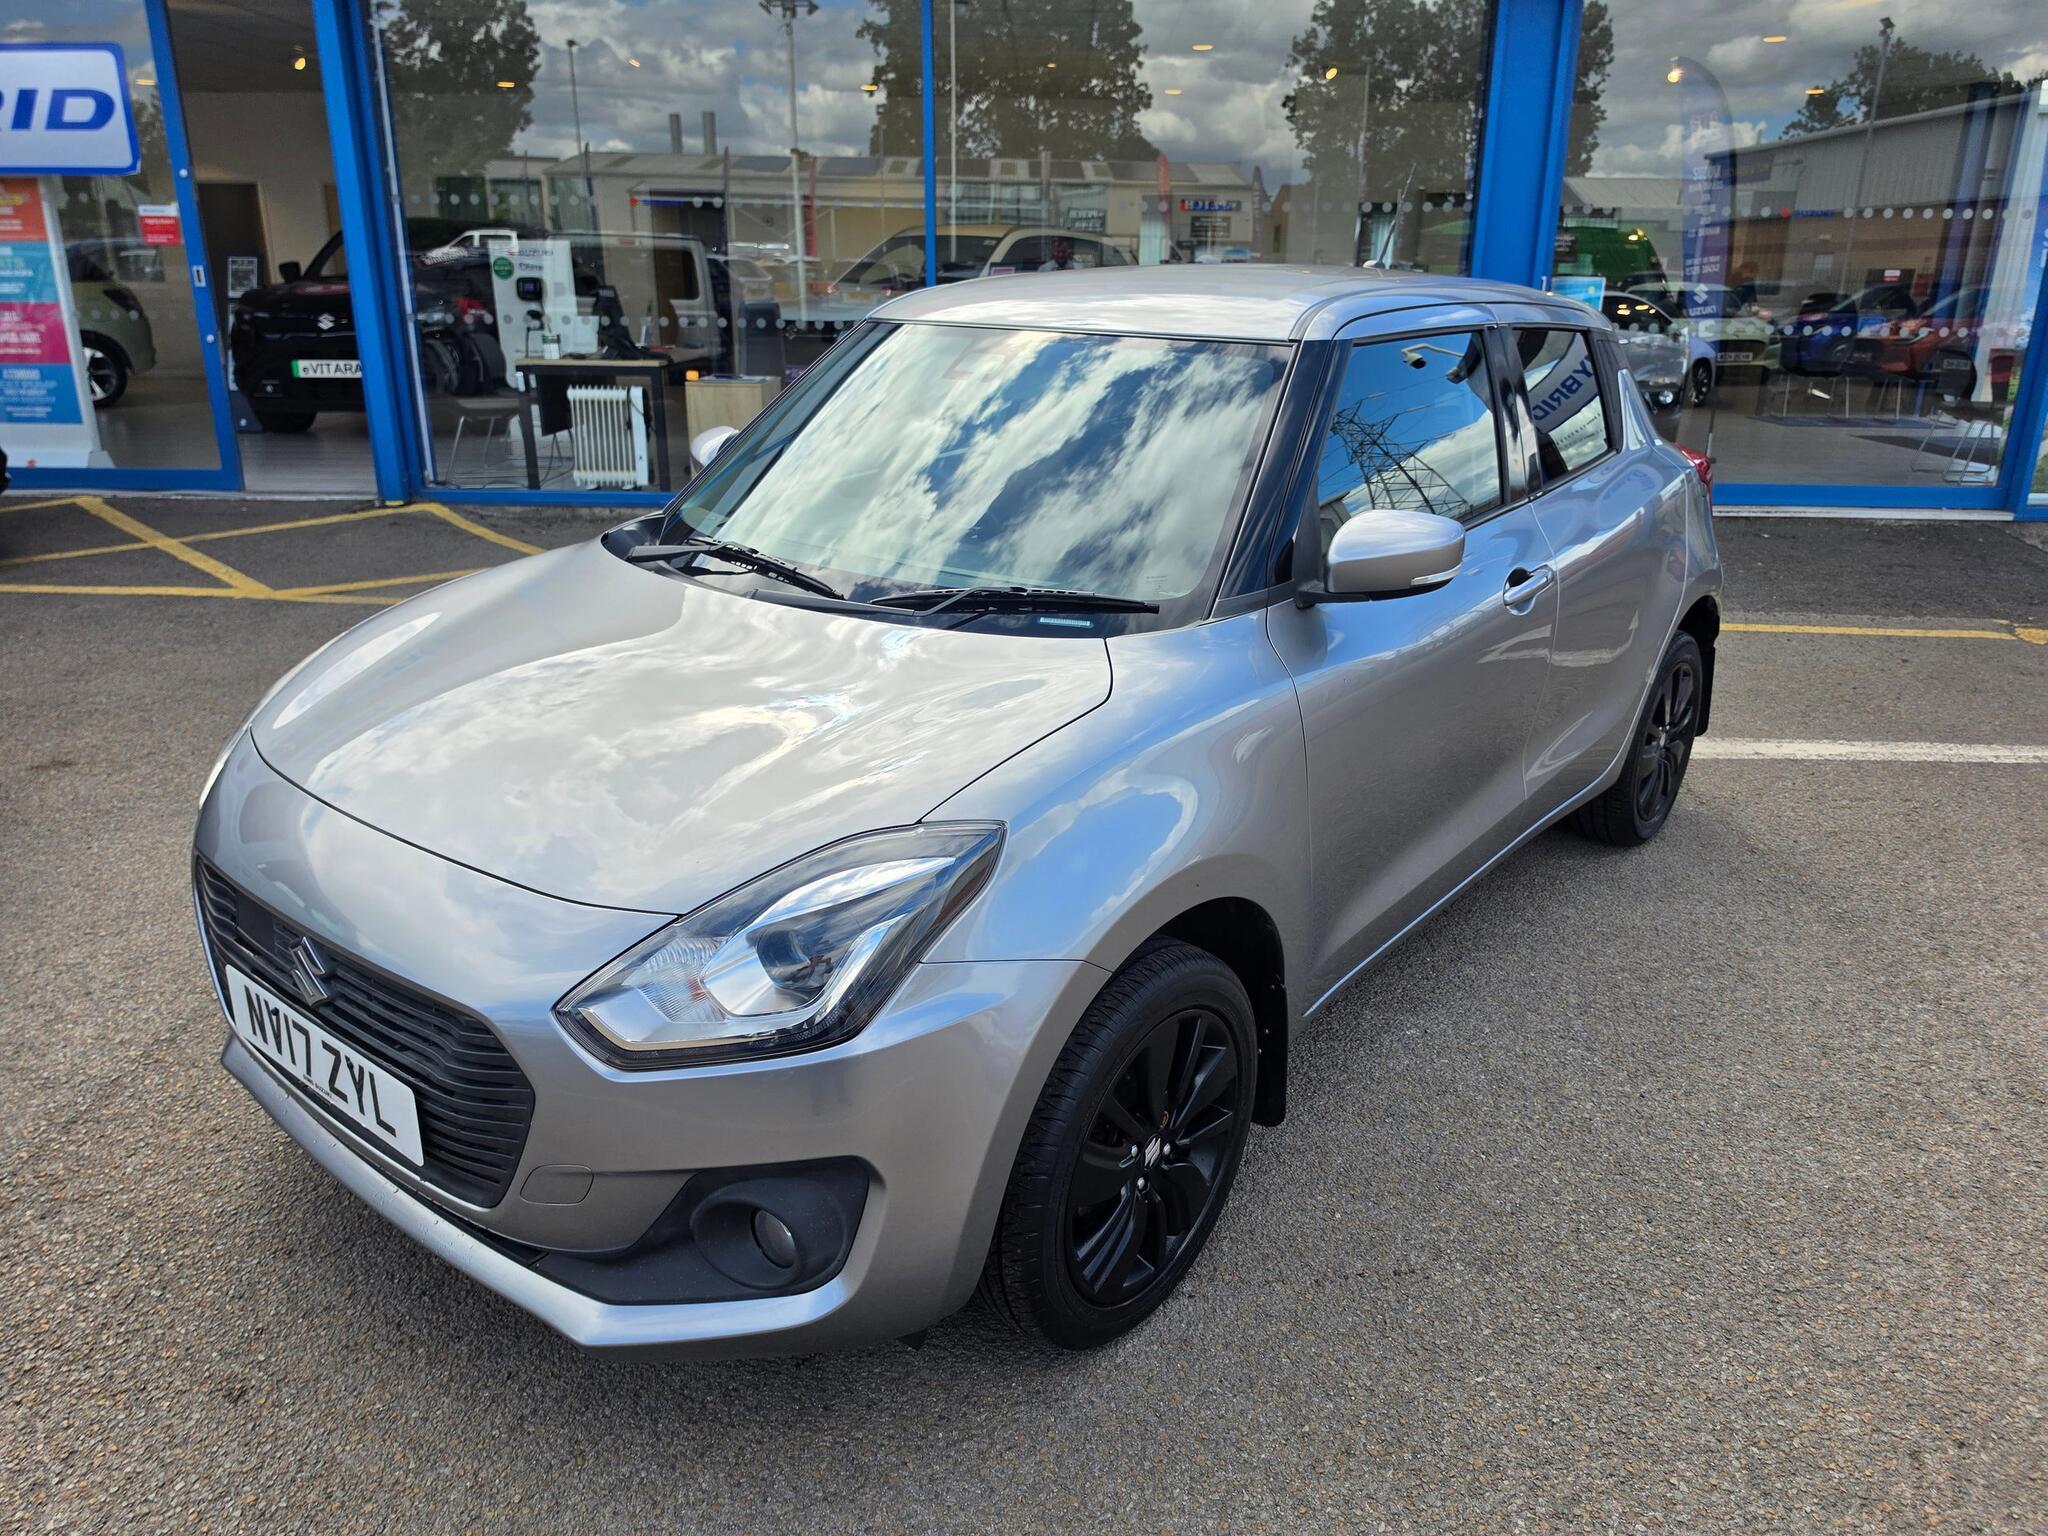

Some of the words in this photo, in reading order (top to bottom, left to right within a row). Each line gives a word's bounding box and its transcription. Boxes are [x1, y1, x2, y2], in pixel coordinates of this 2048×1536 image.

[0, 89, 115, 131] ID
[244, 984, 312, 1078] NY17
[321, 1039, 397, 1138] ZYL
